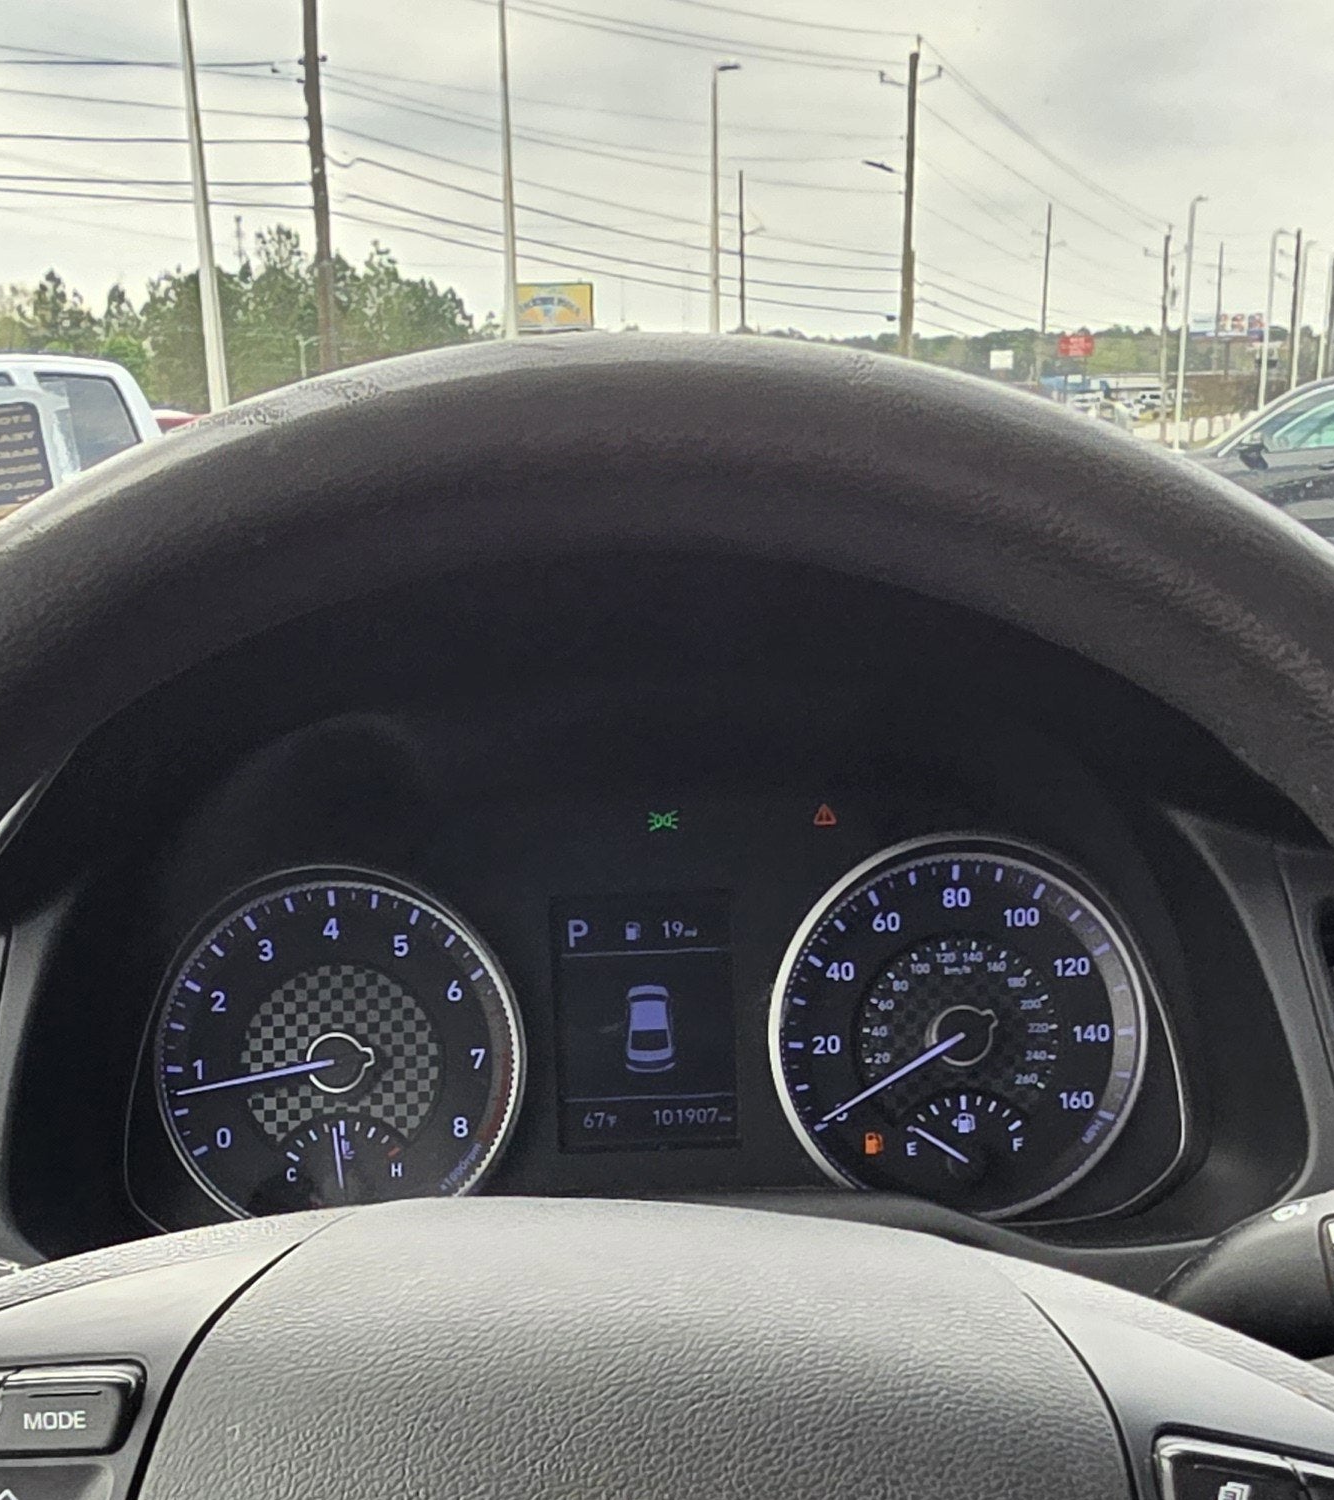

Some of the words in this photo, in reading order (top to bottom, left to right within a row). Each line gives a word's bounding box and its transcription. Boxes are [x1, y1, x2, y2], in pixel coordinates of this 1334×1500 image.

[942, 888, 971, 908] 80
[872, 912, 901, 932] 60
[1003, 907, 1040, 927] 100
[323, 918, 339, 940] 4
[568, 919, 589, 948] P
[258, 940, 273, 961] 3
[393, 935, 408, 957] 5
[935, 952, 957, 963] 120
[962, 951, 983, 963] 140
[1054, 957, 1090, 977] 120
[826, 961, 854, 982] 40
[910, 963, 931, 975] 100
[447, 980, 462, 1001] 6
[892, 980, 909, 992] 80
[211, 991, 225, 1012] 2
[878, 1000, 894, 1011] 60
[871, 1026, 888, 1037] 40
[1028, 1022, 1049, 1033] 220
[1073, 1024, 1110, 1044] 140
[812, 1034, 841, 1055] 20
[470, 1048, 485, 1070] 7
[874, 1053, 890, 1064] 20
[1025, 1050, 1046, 1061] 240
[193, 1060, 203, 1080] 1
[1015, 1073, 1038, 1085] 260
[1059, 1091, 1094, 1110] 160
[653, 1107, 719, 1126] 101907
[453, 1117, 468, 1138] 8
[216, 1128, 231, 1149] 0
[1013, 1137, 1023, 1152] F
[906, 1142, 917, 1157] E
[286, 1168, 297, 1182] C
[391, 1164, 402, 1178] H
[23, 1410, 87, 1430] MODE
